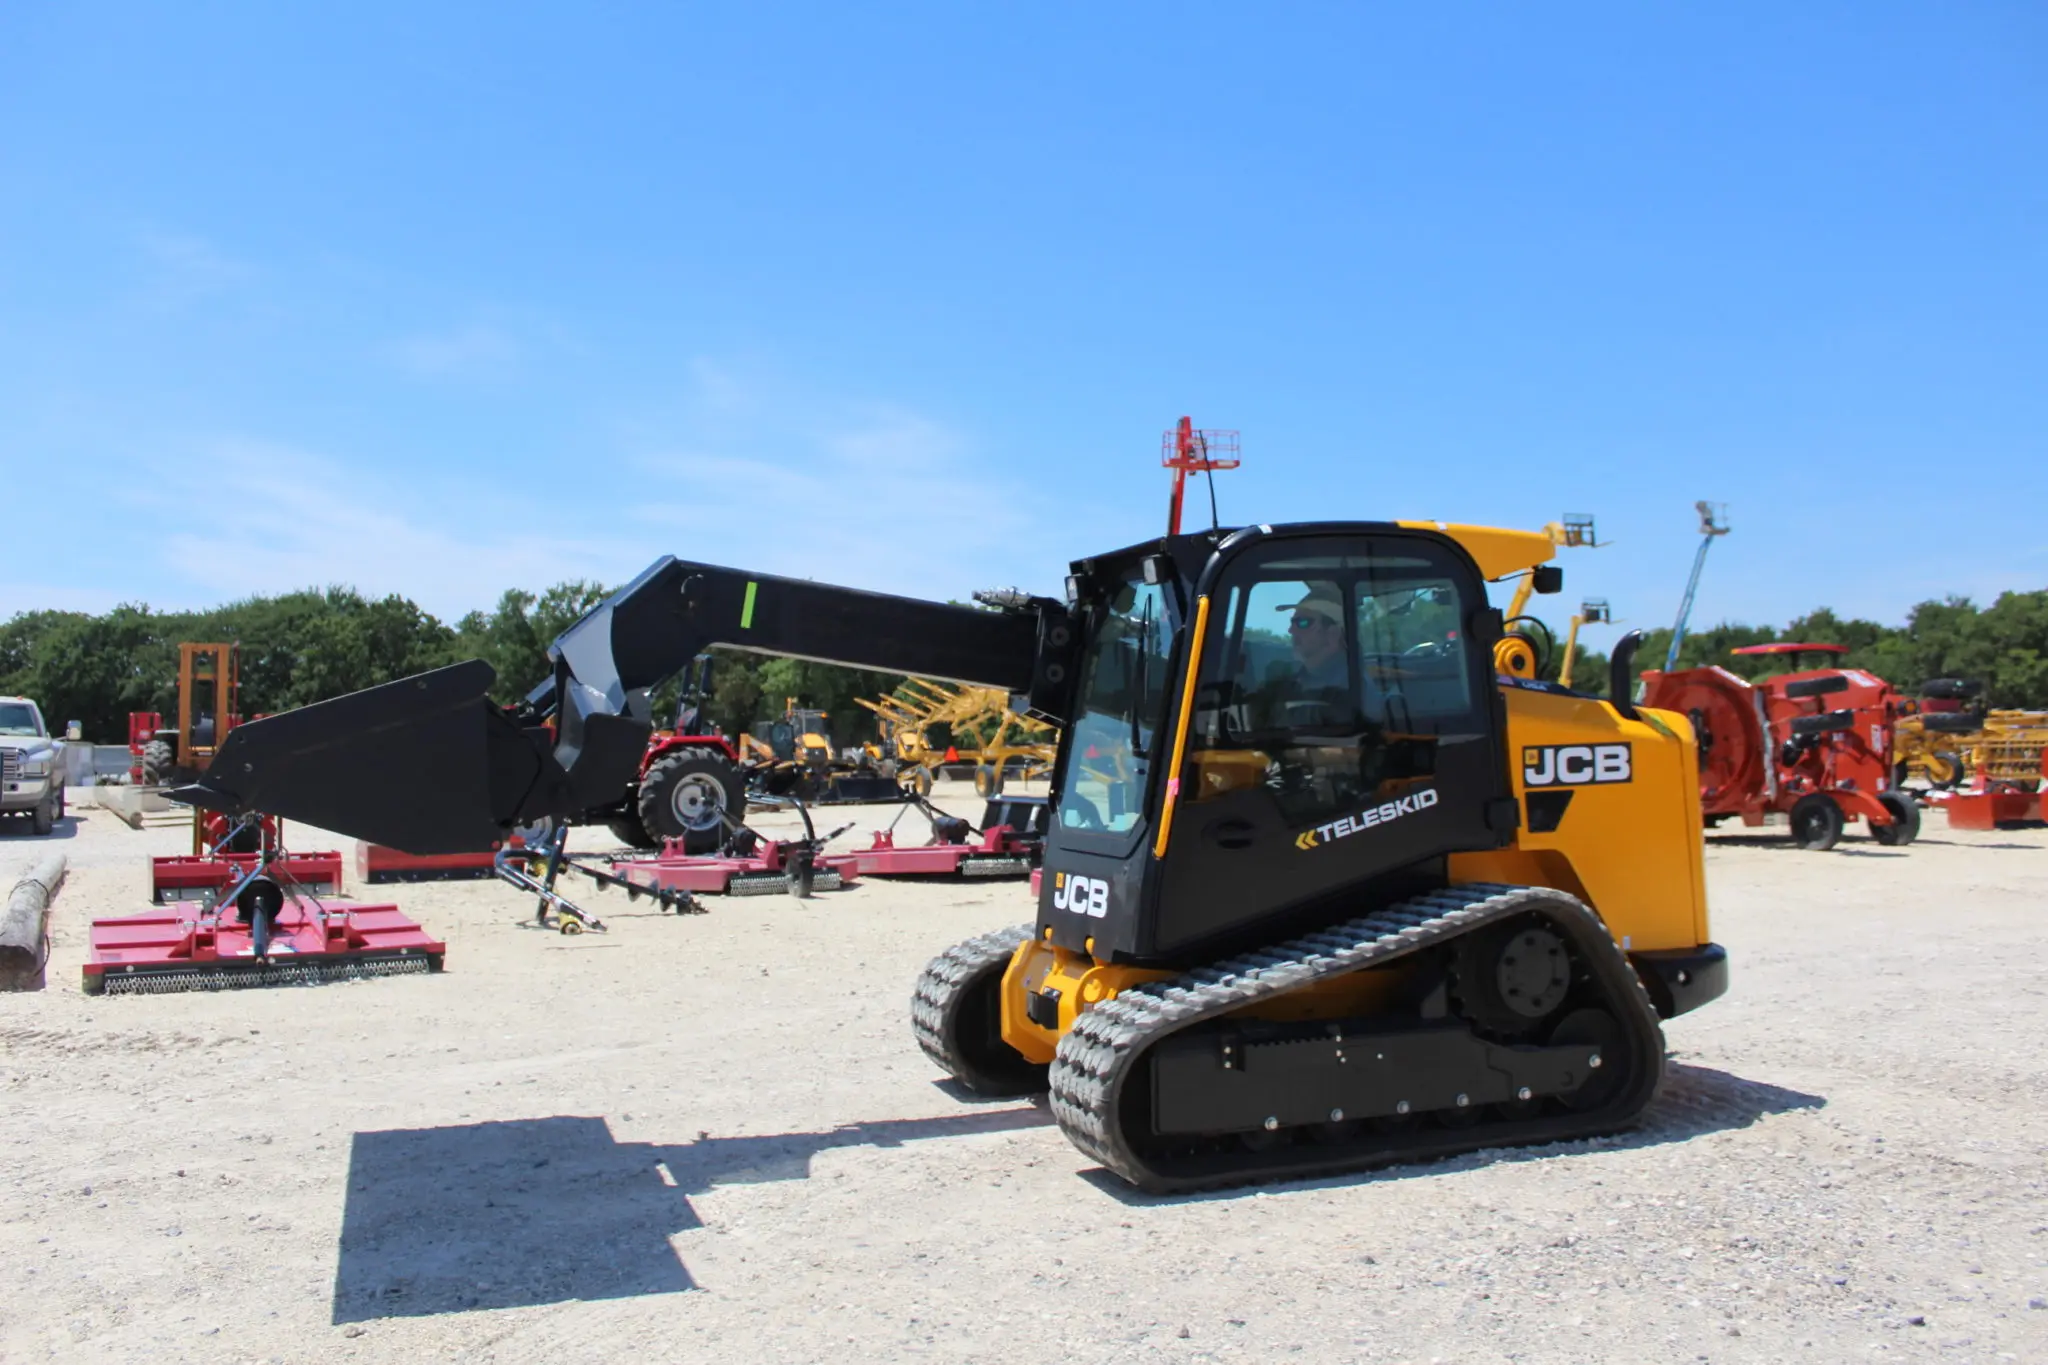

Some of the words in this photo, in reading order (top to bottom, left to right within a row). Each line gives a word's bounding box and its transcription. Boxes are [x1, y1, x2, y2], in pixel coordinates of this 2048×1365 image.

[1525, 745, 1630, 785] JCB
[1316, 788, 1439, 842] TELESKID
[1054, 874, 1109, 918] JCB
